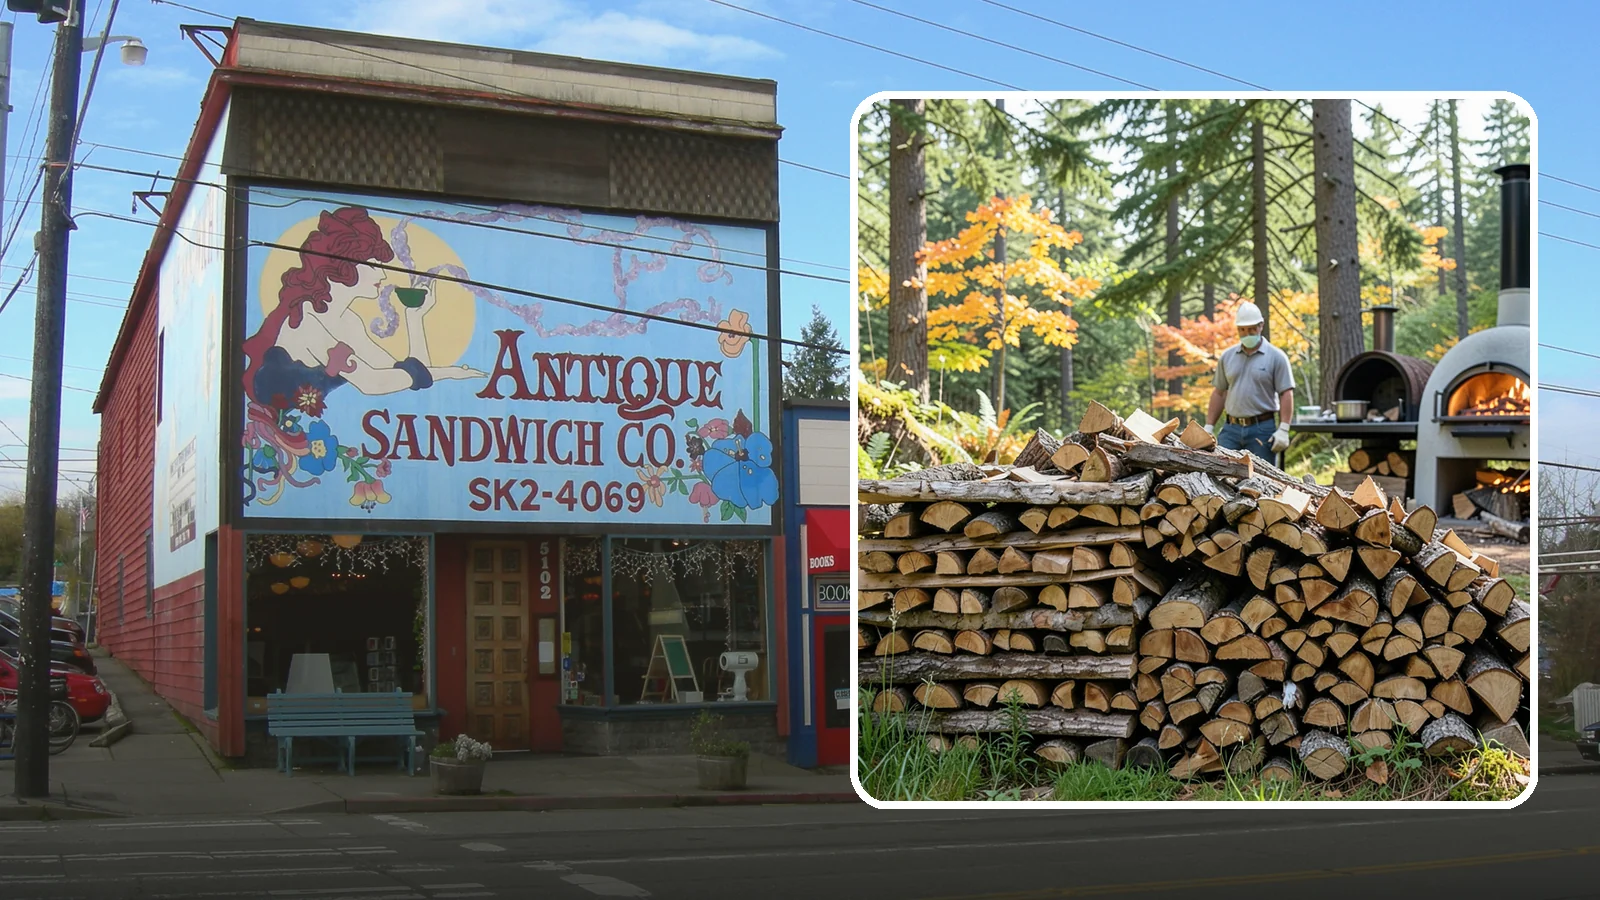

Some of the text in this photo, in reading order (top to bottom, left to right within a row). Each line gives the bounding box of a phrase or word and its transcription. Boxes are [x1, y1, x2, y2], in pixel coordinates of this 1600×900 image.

[477, 330, 724, 420] ANTIQUE
[361, 409, 685, 468] SANDWICH CO.
[468, 477, 645, 513] SK2-4069
[539, 541, 552, 600] 5102
[809, 555, 835, 569] BOOKS
